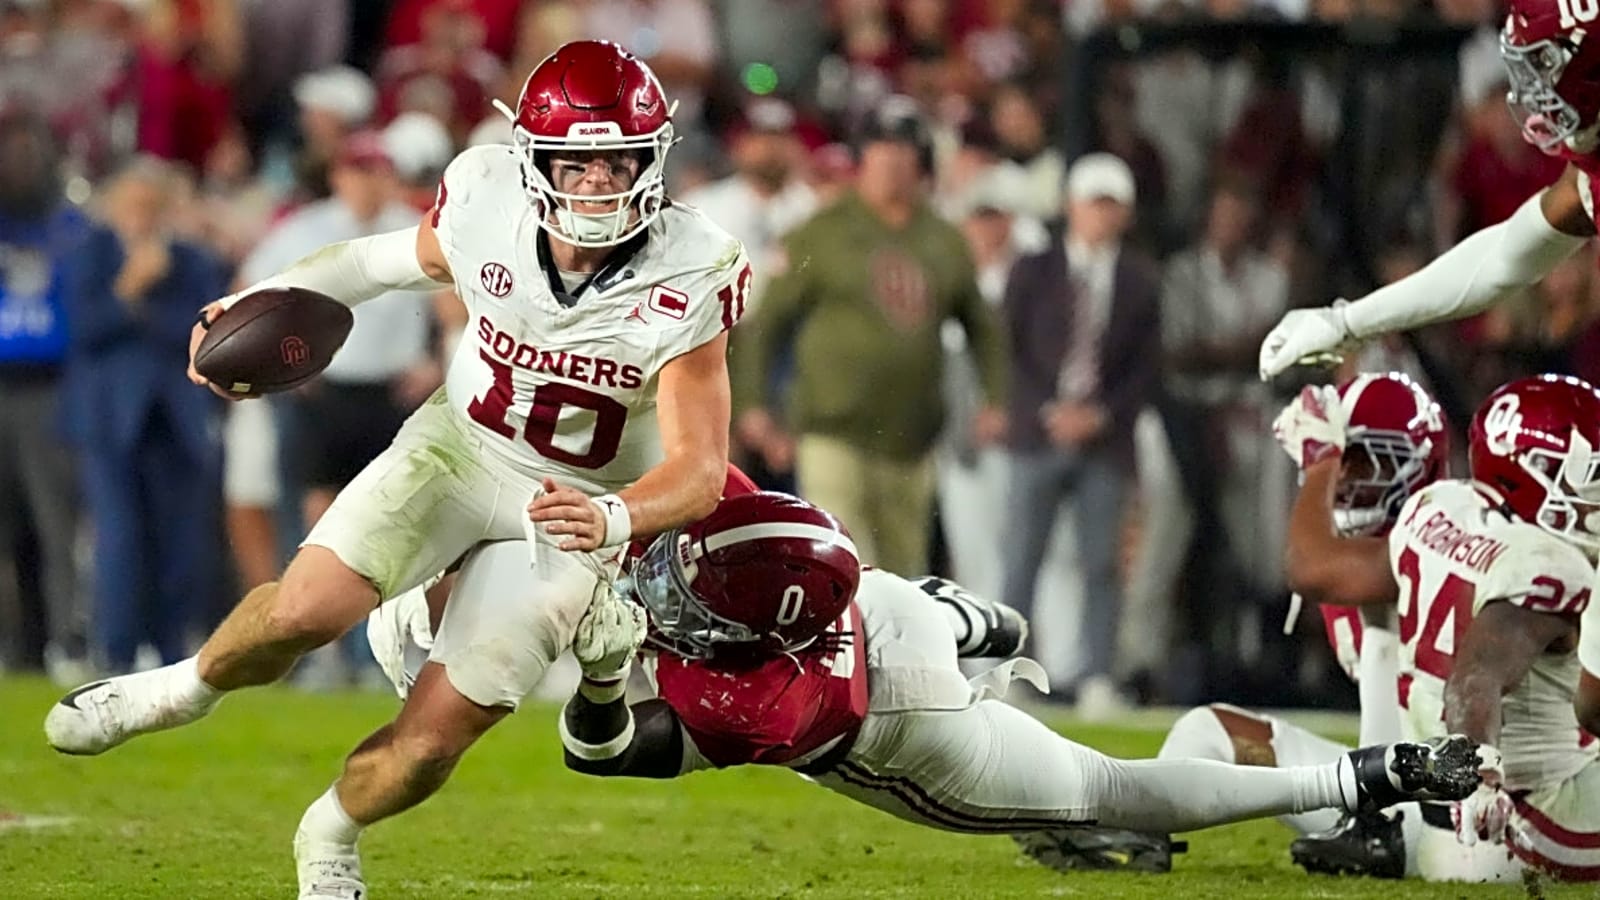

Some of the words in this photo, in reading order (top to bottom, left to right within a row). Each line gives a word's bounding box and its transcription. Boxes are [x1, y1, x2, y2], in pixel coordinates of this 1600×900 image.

[481, 263, 512, 297] SEC
[477, 316, 644, 389] SOONERS
[467, 347, 628, 470] 10
[1415, 510, 1510, 575] ROBINSON
[776, 585, 804, 625] 0
